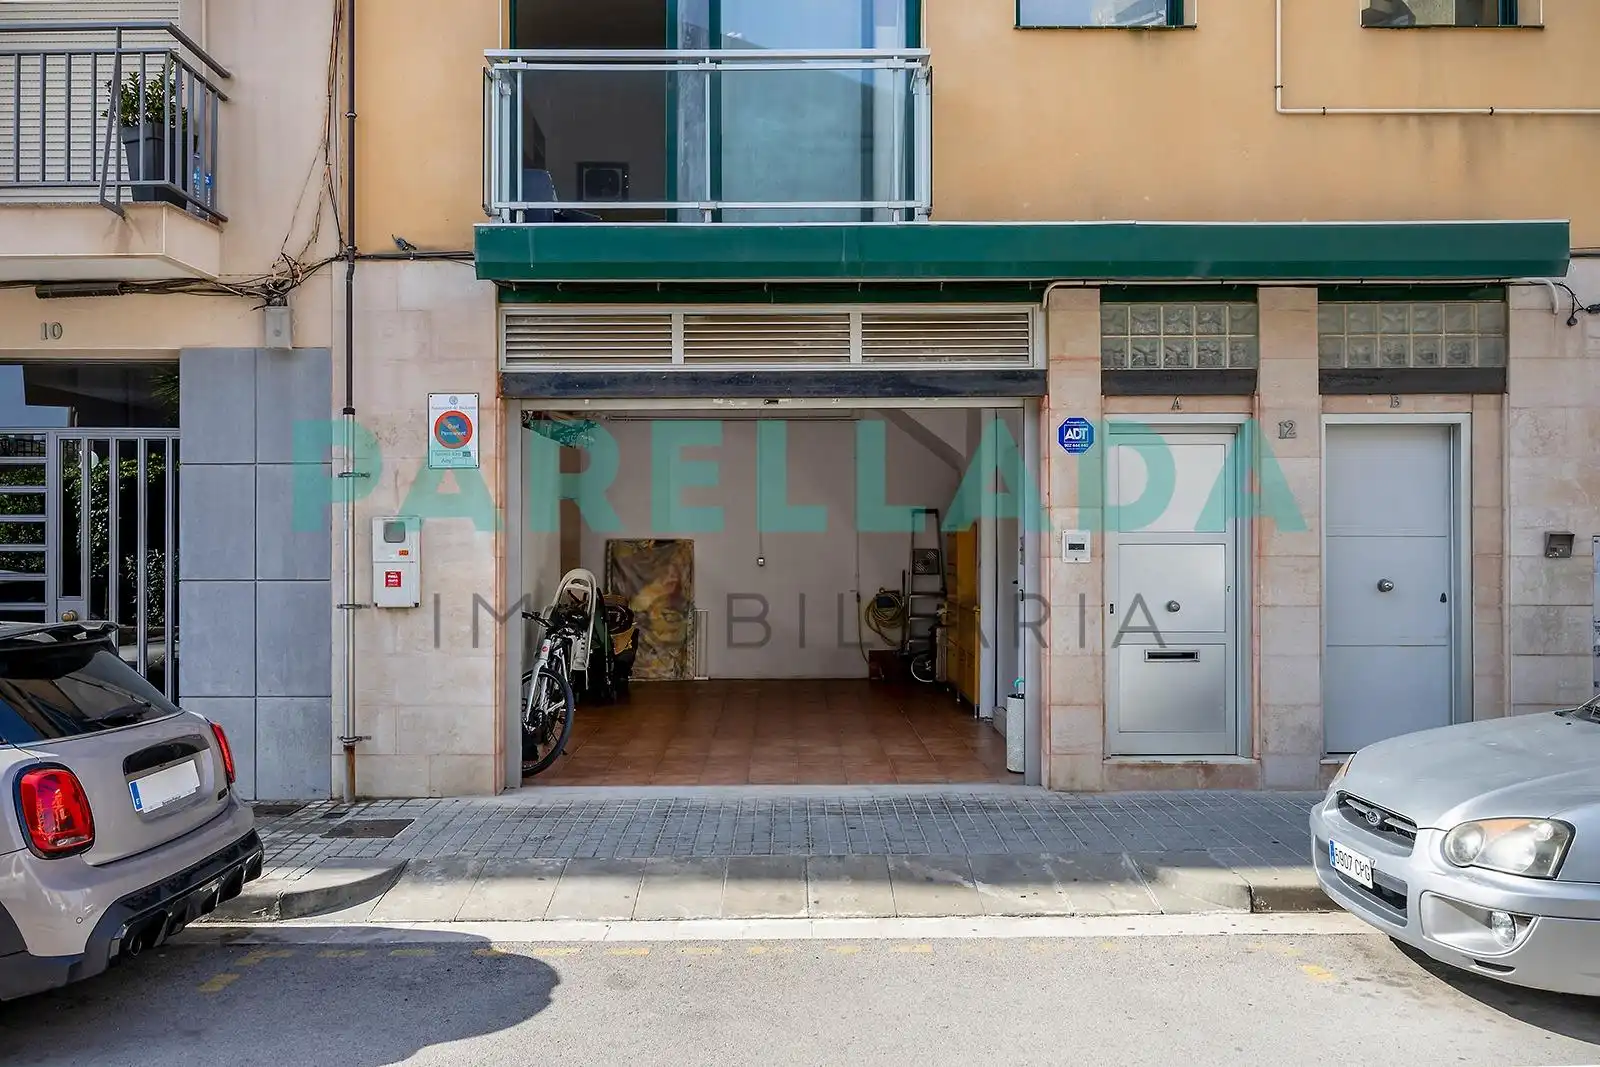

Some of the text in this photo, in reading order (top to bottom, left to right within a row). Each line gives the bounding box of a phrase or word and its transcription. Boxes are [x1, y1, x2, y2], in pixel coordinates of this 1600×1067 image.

[40, 321, 63, 340] 10
[1171, 395, 1182, 410] A
[1389, 393, 1400, 408] B
[1065, 428, 1088, 440] ADT
[1278, 421, 1297, 439] 12
